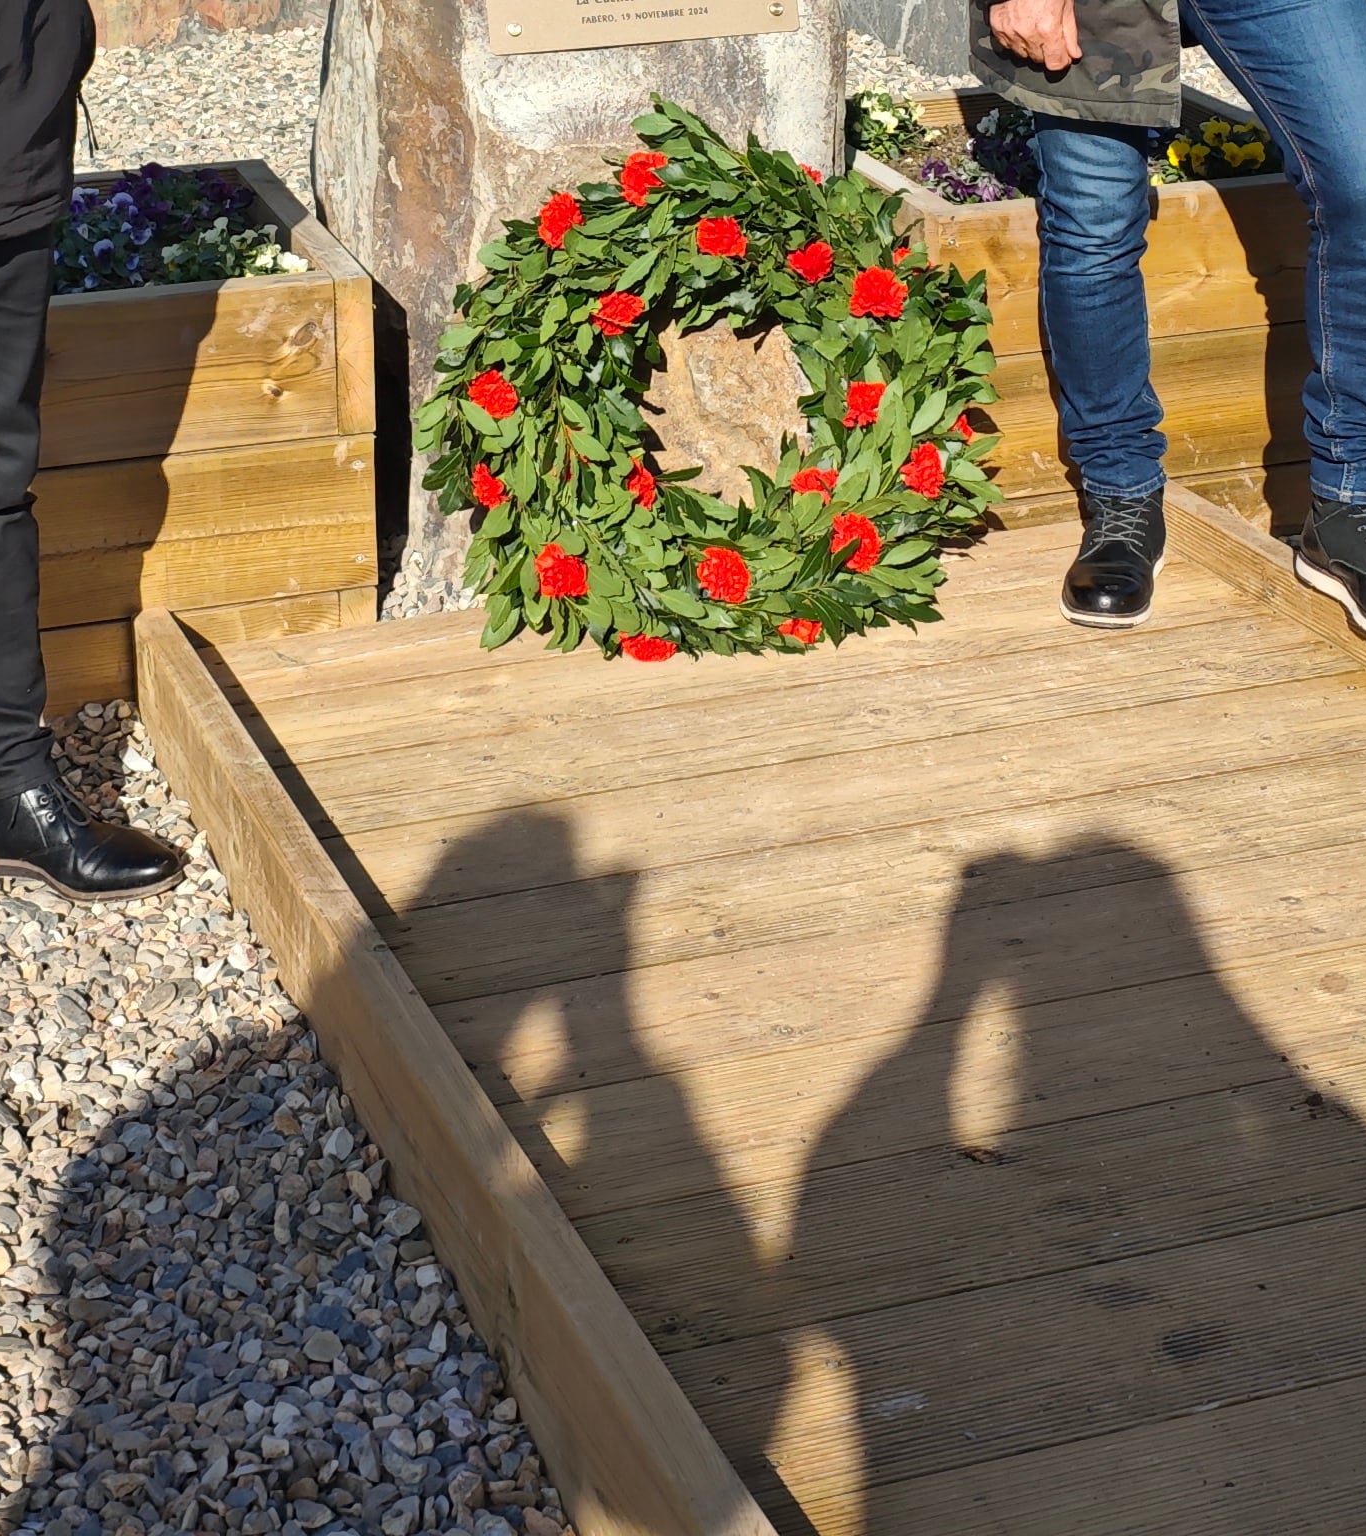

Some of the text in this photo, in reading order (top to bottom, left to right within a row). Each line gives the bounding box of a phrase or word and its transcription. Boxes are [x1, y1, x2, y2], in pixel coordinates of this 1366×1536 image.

[581, 6, 709, 25] FABERO, 19 NOVIEMBRE 2024
